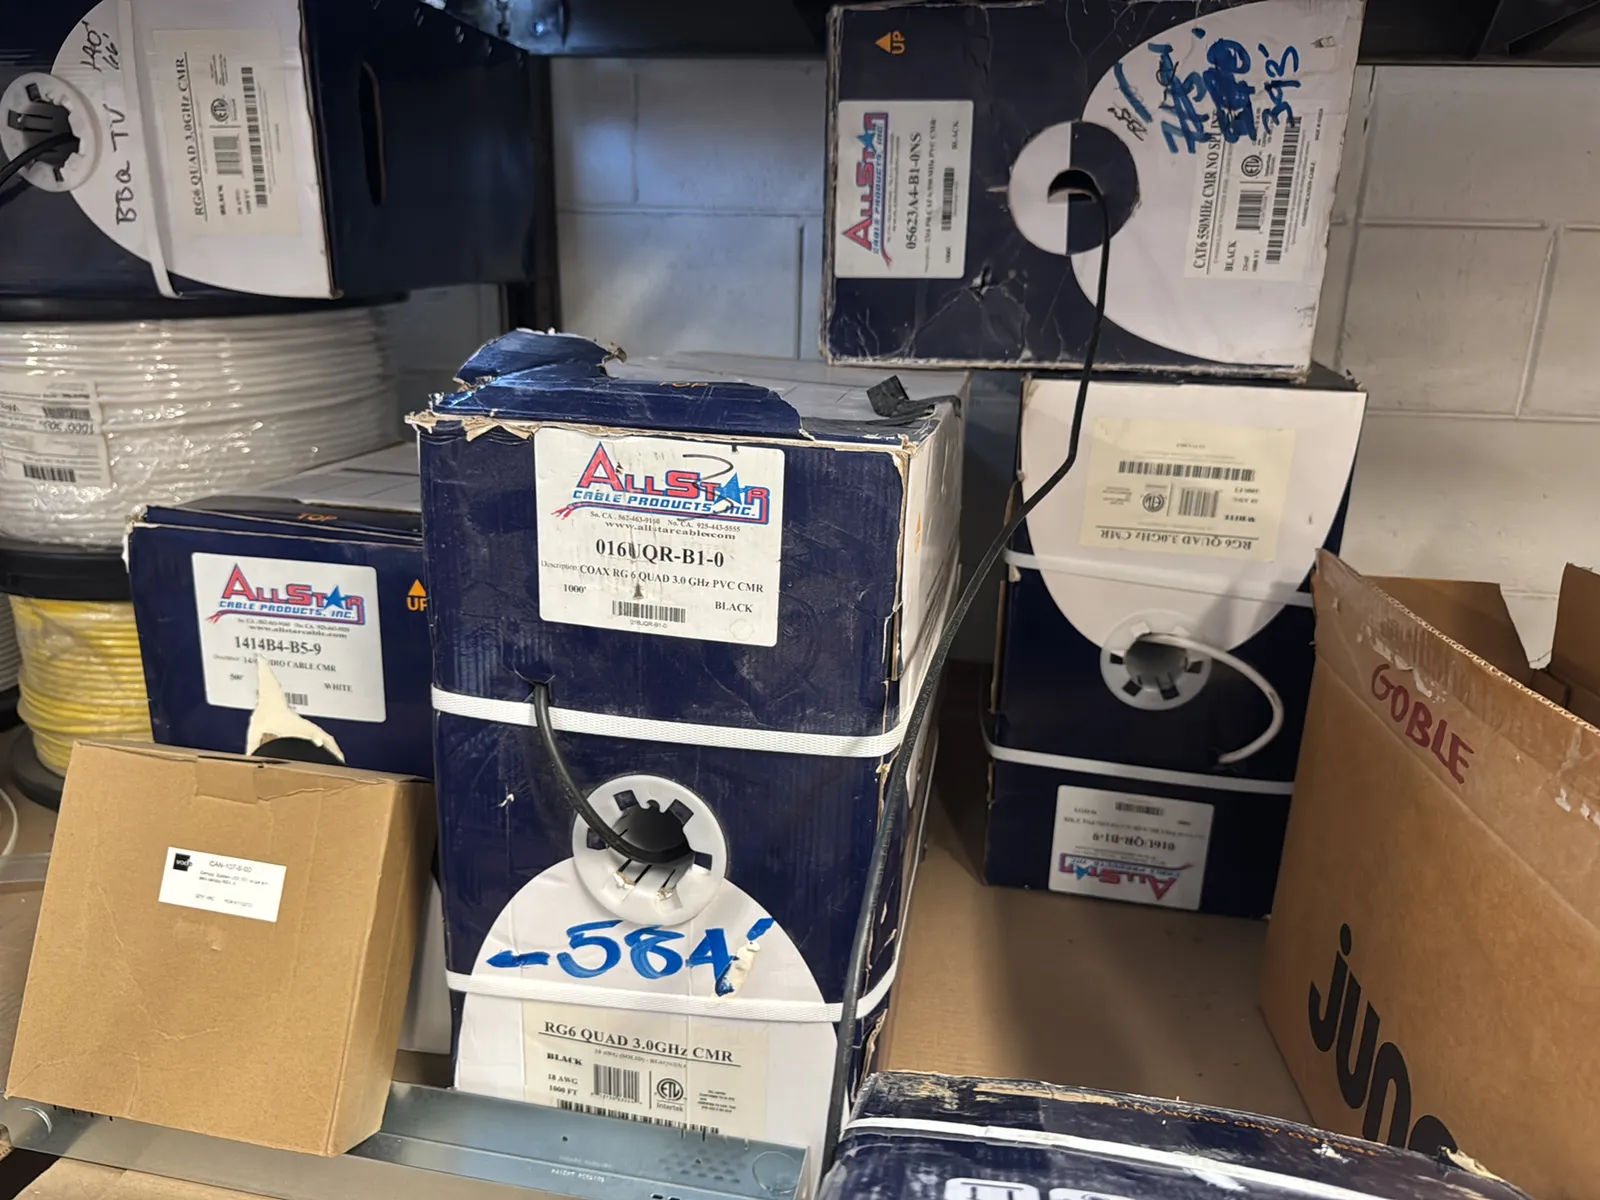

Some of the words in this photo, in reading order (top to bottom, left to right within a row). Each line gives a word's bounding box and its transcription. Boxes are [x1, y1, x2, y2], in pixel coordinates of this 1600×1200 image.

[890, 30, 906, 54] UP
[174, 58, 188, 92] CMR
[103, 104, 128, 152] TV
[186, 146, 201, 186] QUAD
[1206, 152, 1220, 170] NO
[114, 160, 136, 224] BBQ
[1202, 171, 1216, 198] CMR
[192, 188, 204, 216] RG6
[1196, 200, 1213, 240] 550MHz
[1192, 241, 1208, 269] CAT6
[1224, 240, 1237, 272] BLACK
[573, 490, 622, 503] CABLE
[1100, 530, 1132, 541] CMR
[1135, 531, 1178, 544] 3.0GHz
[1182, 535, 1221, 548] QUAD
[1224, 539, 1252, 550] RG6
[596, 538, 724, 567] 016UQR-B1-0
[580, 564, 610, 576] COAX
[630, 571, 636, 579] 6
[638, 572, 670, 583] QUAD
[672, 575, 686, 584] 3.0
[688, 577, 710, 587] GHz
[713, 580, 735, 590] PVC
[738, 582, 764, 592] CMR
[219, 600, 256, 610] CABLE
[331, 610, 356, 620] INC.
[714, 600, 753, 614] BLACK
[235, 636, 322, 655] 1414B4-B5-9
[324, 683, 353, 692] WHITE
[1371, 664, 1474, 784] GOBLE
[544, 1021, 577, 1038] RG6
[580, 1028, 629, 1046] QUAD
[632, 1037, 688, 1057] 3.0GHz
[692, 1046, 733, 1062] CMR
[546, 1052, 583, 1066] BLACK
[558, 1076, 578, 1085] AWG
[567, 1088, 578, 1096] FT
[656, 1102, 684, 1112] Intertek
